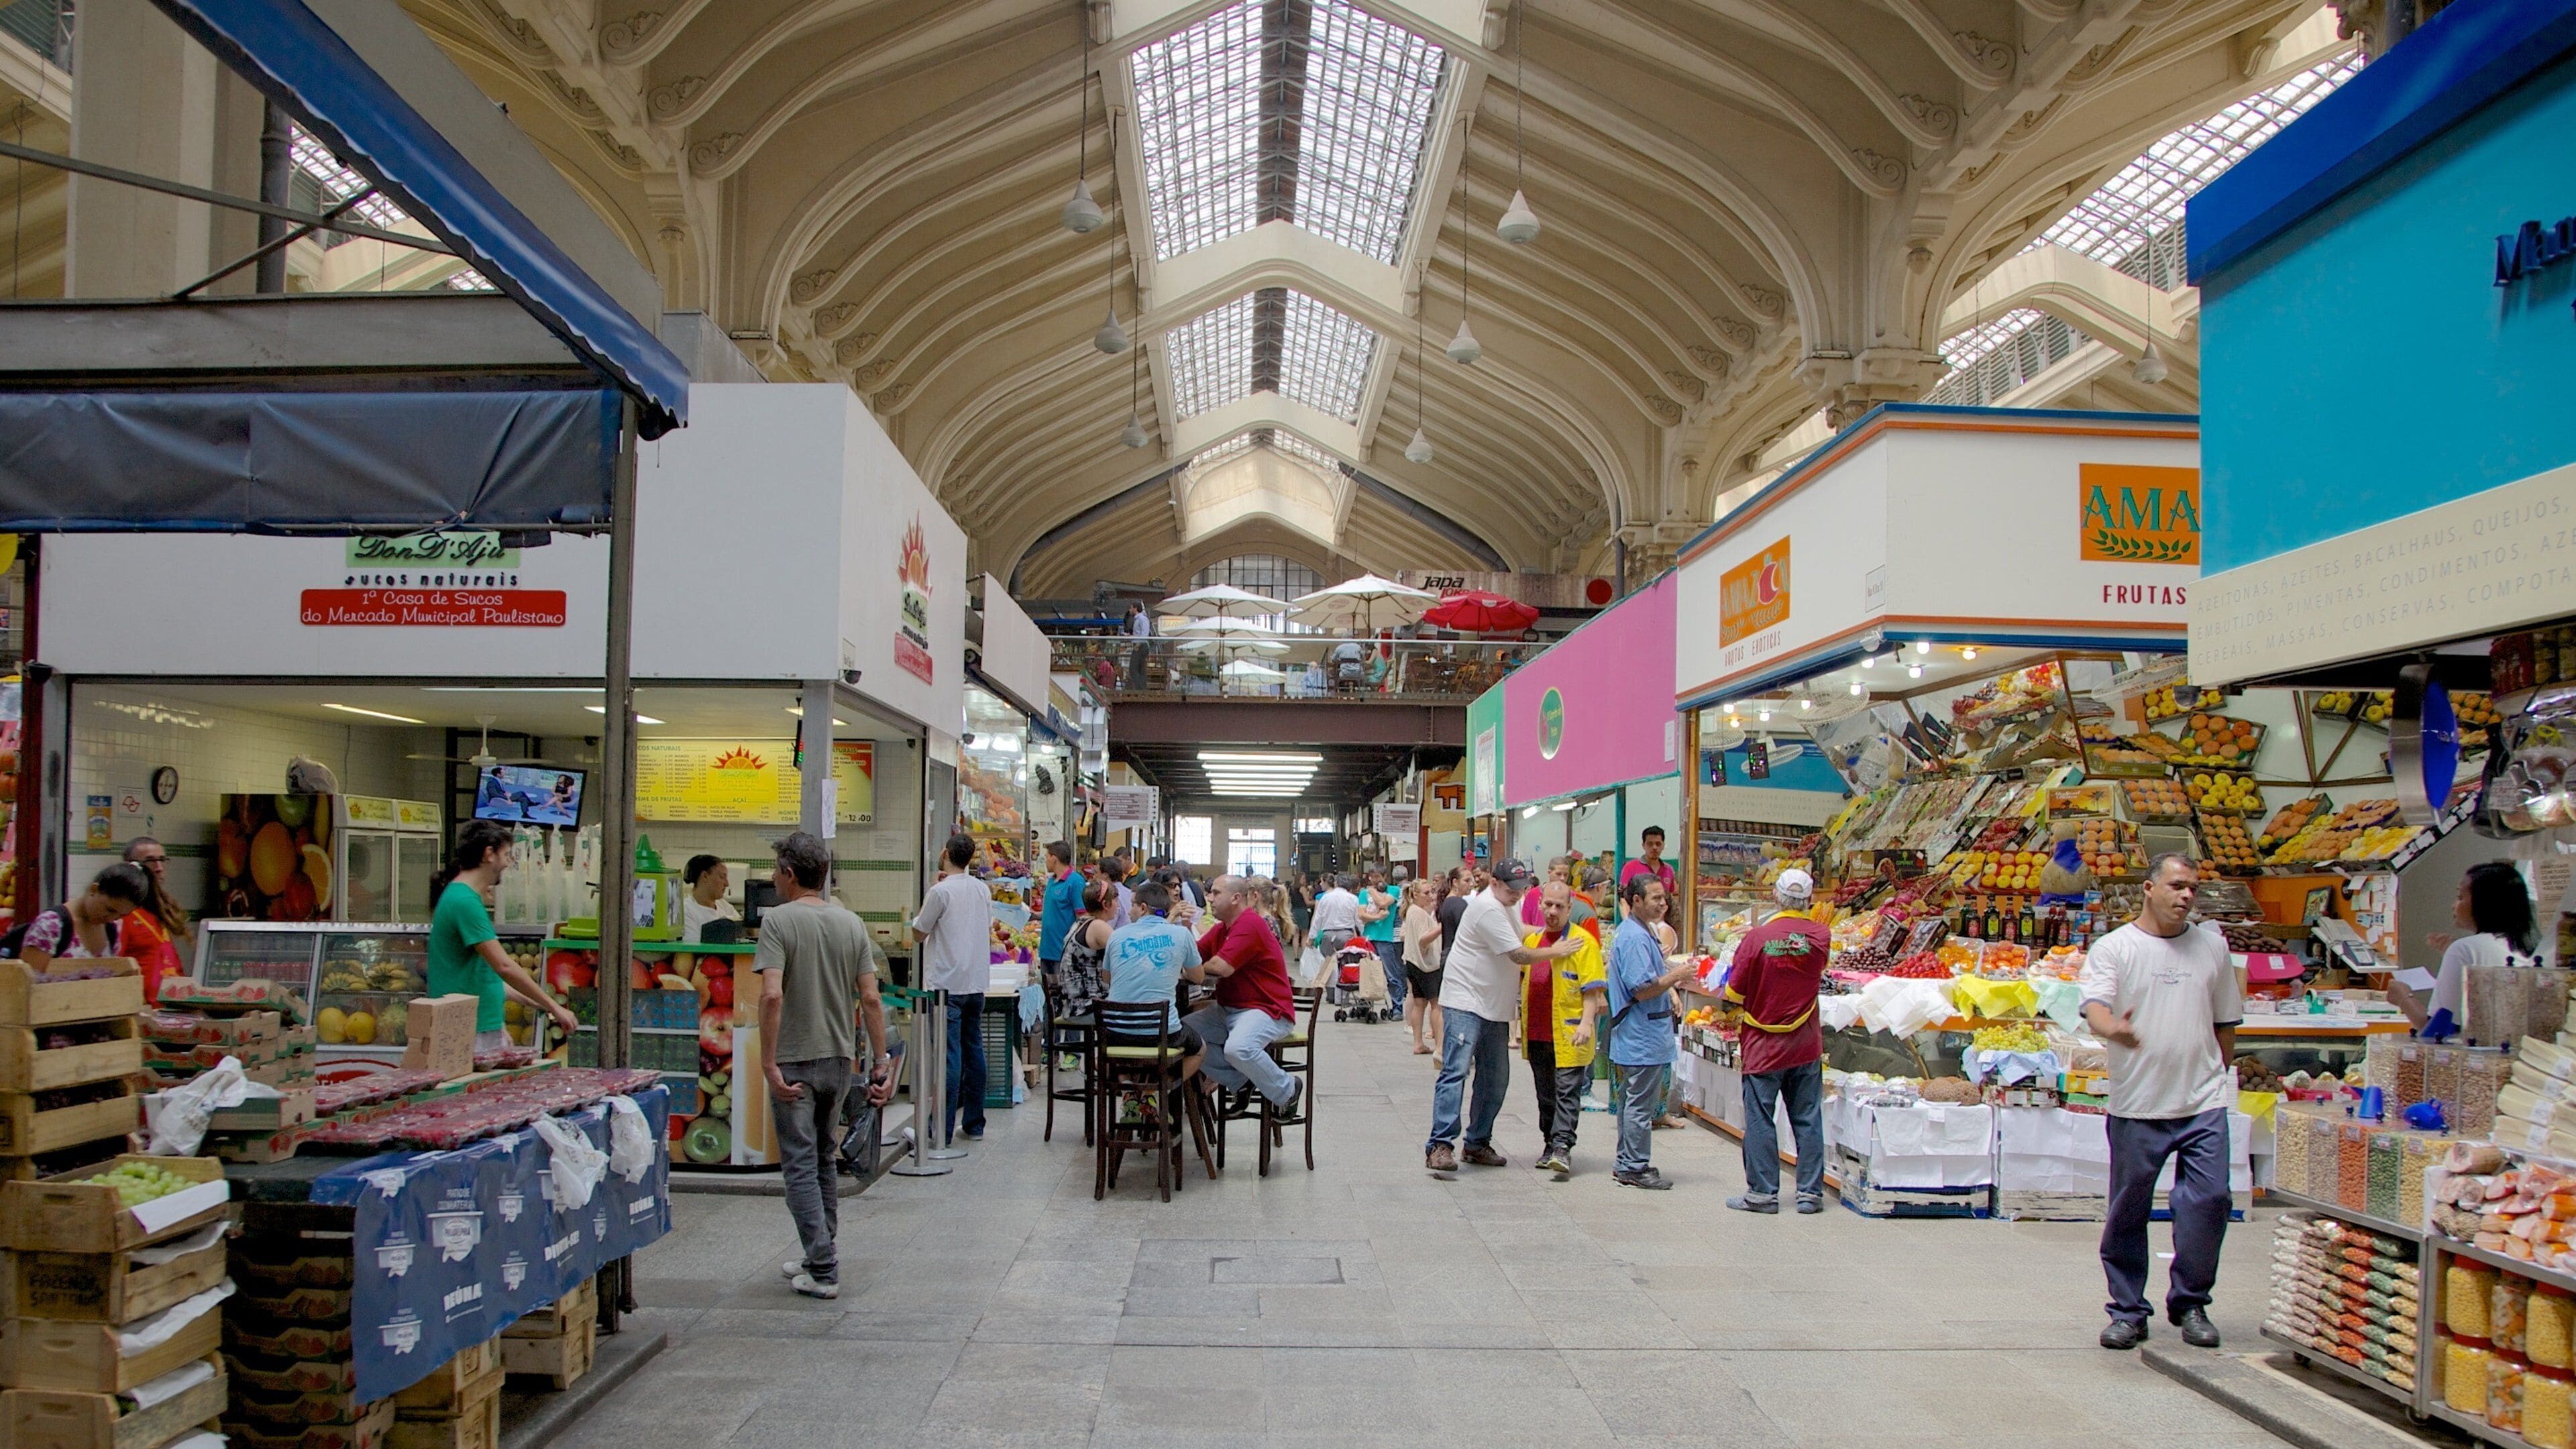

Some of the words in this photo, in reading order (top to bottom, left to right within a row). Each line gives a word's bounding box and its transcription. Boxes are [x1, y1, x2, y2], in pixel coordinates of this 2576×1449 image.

[2082, 485, 2201, 532] AMA
[2197, 580, 2274, 613] AZEITONAS,
[2281, 559, 2346, 589] AZEITES,
[2354, 527, 2463, 570] BACALHAUS,
[2473, 496, 2570, 535] QUEIJOS,
[345, 573, 408, 586] sucos
[420, 571, 518, 587] naturais
[2103, 584, 2186, 605] FRUTAS
[2197, 607, 2279, 641] EMBUTIDOS,
[2286, 583, 2370, 616] PIMENTAS,
[2380, 543, 2528, 592] CONDIMENTOS,
[383, 591, 425, 605] Casa
[430, 591, 448, 605] de
[455, 591, 503, 605] Sucos
[302, 608, 321, 623] do
[327, 607, 395, 624] Mercado
[400, 607, 476, 626] Municipal
[484, 608, 564, 625] Paulistano
[2196, 640, 2258, 667] CEREAIS,
[2265, 623, 2332, 650] MASSAS,
[2342, 594, 2455, 632] CONSERVAS,
[2467, 566, 2573, 604] COMPOTA
